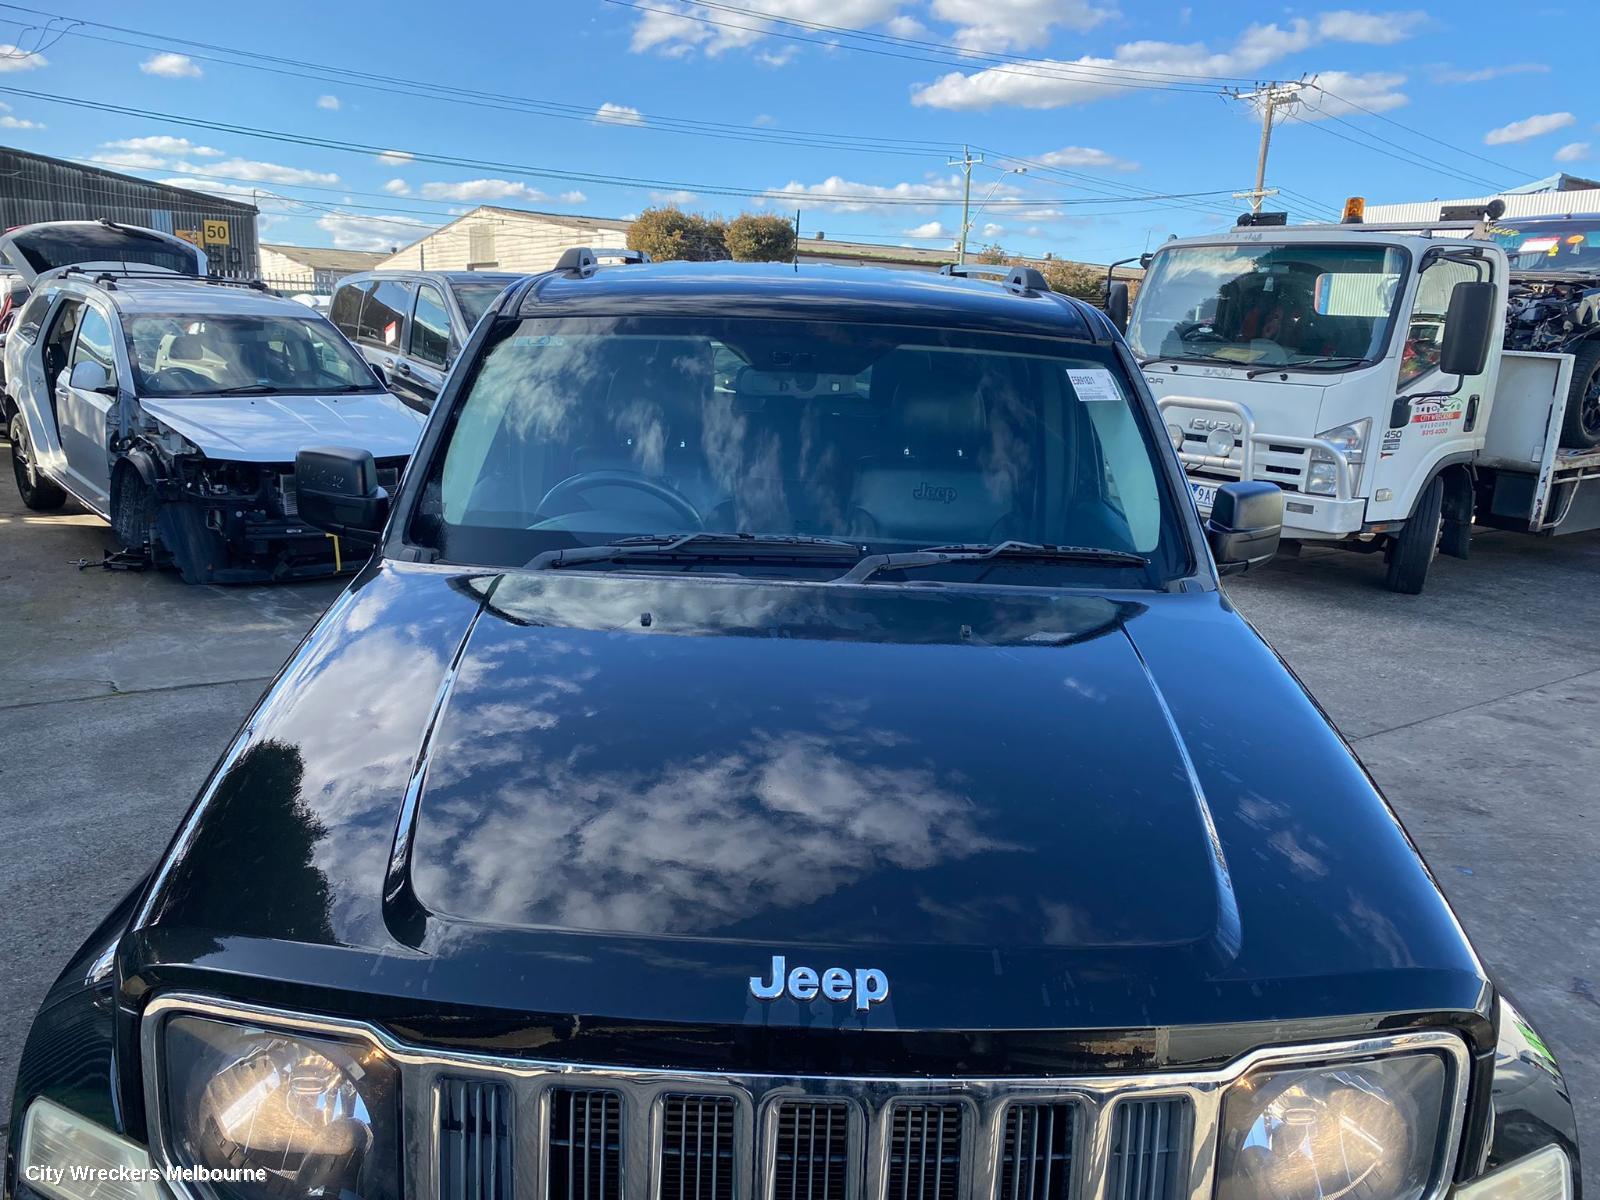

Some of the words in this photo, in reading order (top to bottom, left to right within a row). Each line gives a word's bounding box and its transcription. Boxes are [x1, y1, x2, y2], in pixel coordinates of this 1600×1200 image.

[207, 225, 226, 239] 50
[1189, 418, 1242, 434] ISUZU
[1384, 430, 1402, 438] 450
[913, 481, 957, 504] Jeep
[749, 955, 889, 1011] Jeep
